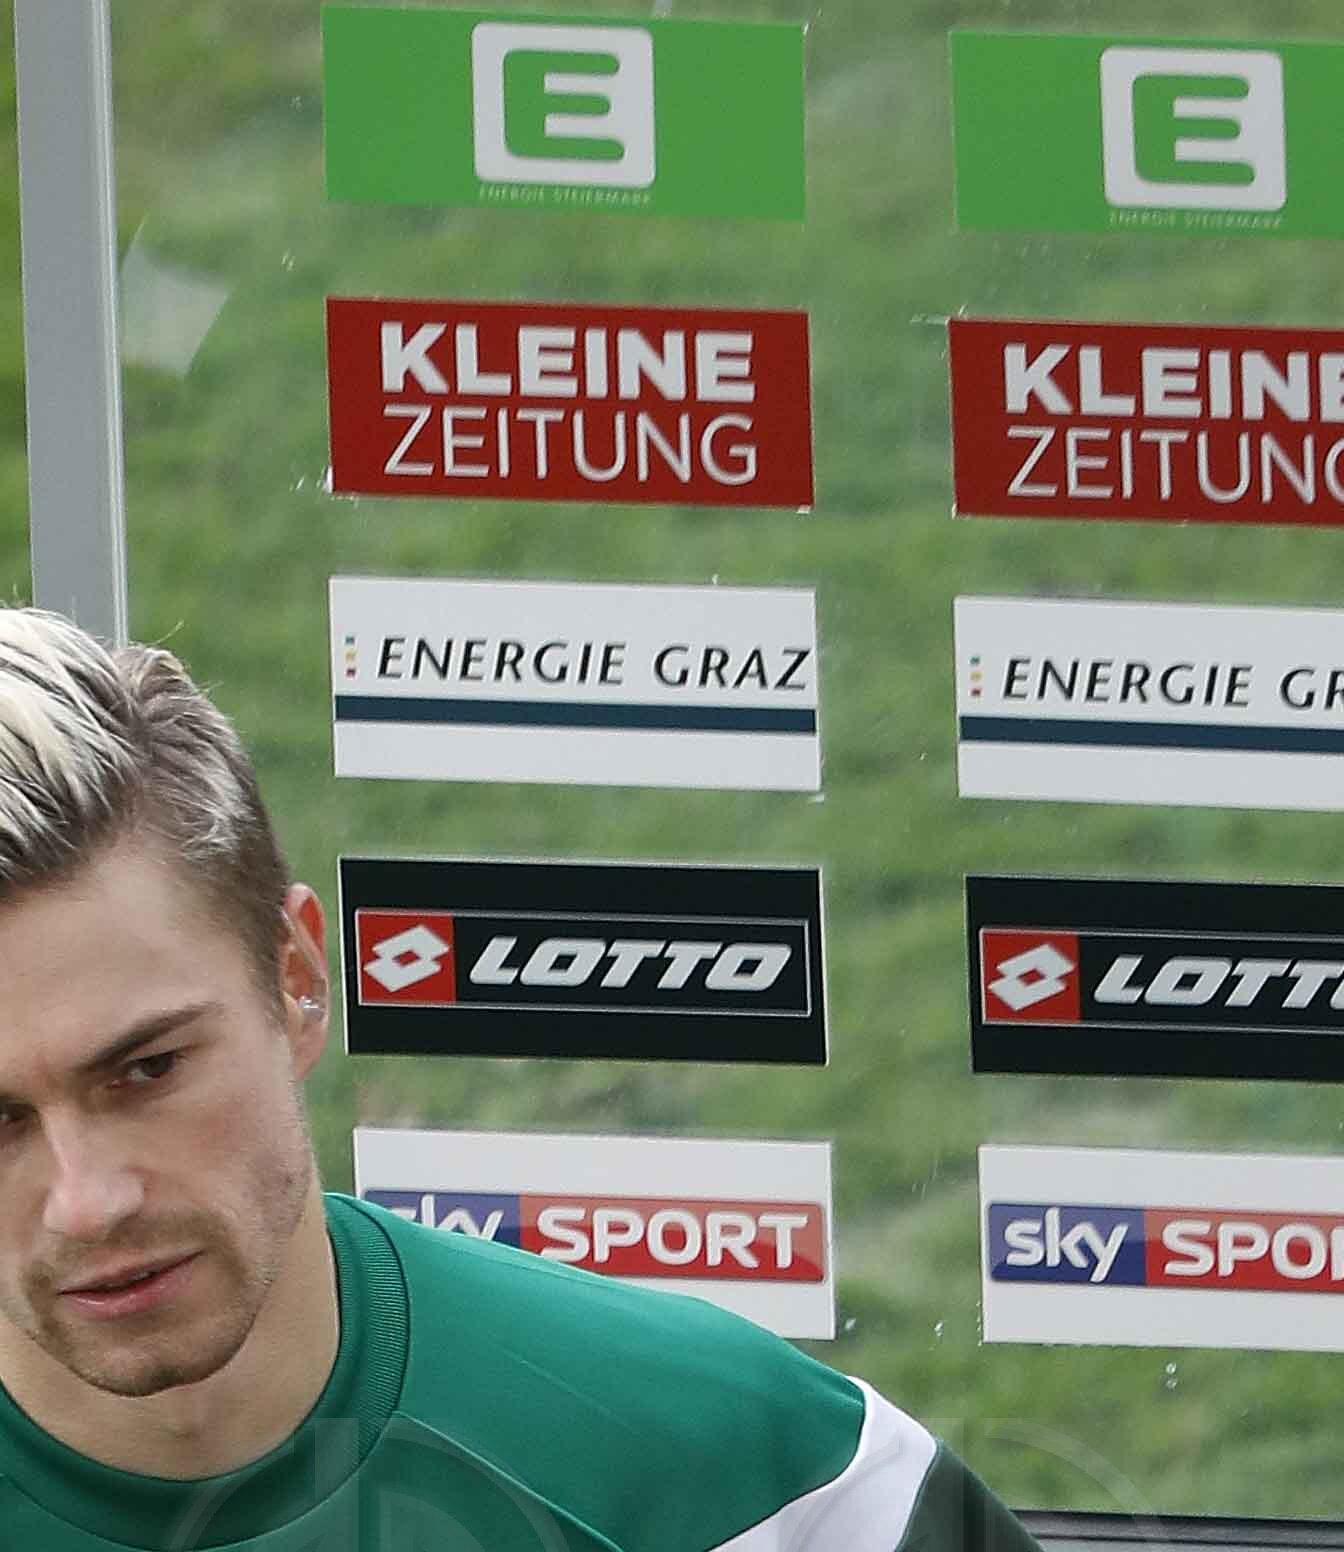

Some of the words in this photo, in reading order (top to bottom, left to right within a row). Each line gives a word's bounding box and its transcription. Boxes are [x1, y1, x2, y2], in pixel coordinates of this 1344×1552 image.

[502, 48, 626, 162] E
[1131, 73, 1256, 188] E
[379, 320, 757, 404] KLEINE
[381, 404, 759, 487] ZEITUNG
[376, 635, 628, 689] ENERGIE
[653, 641, 813, 695] GRAZ
[1002, 656, 1254, 711] ENERGIE
[468, 935, 794, 994] LOTTO
[536, 1206, 809, 1270] SPORT
[1002, 1207, 1130, 1287] sky
